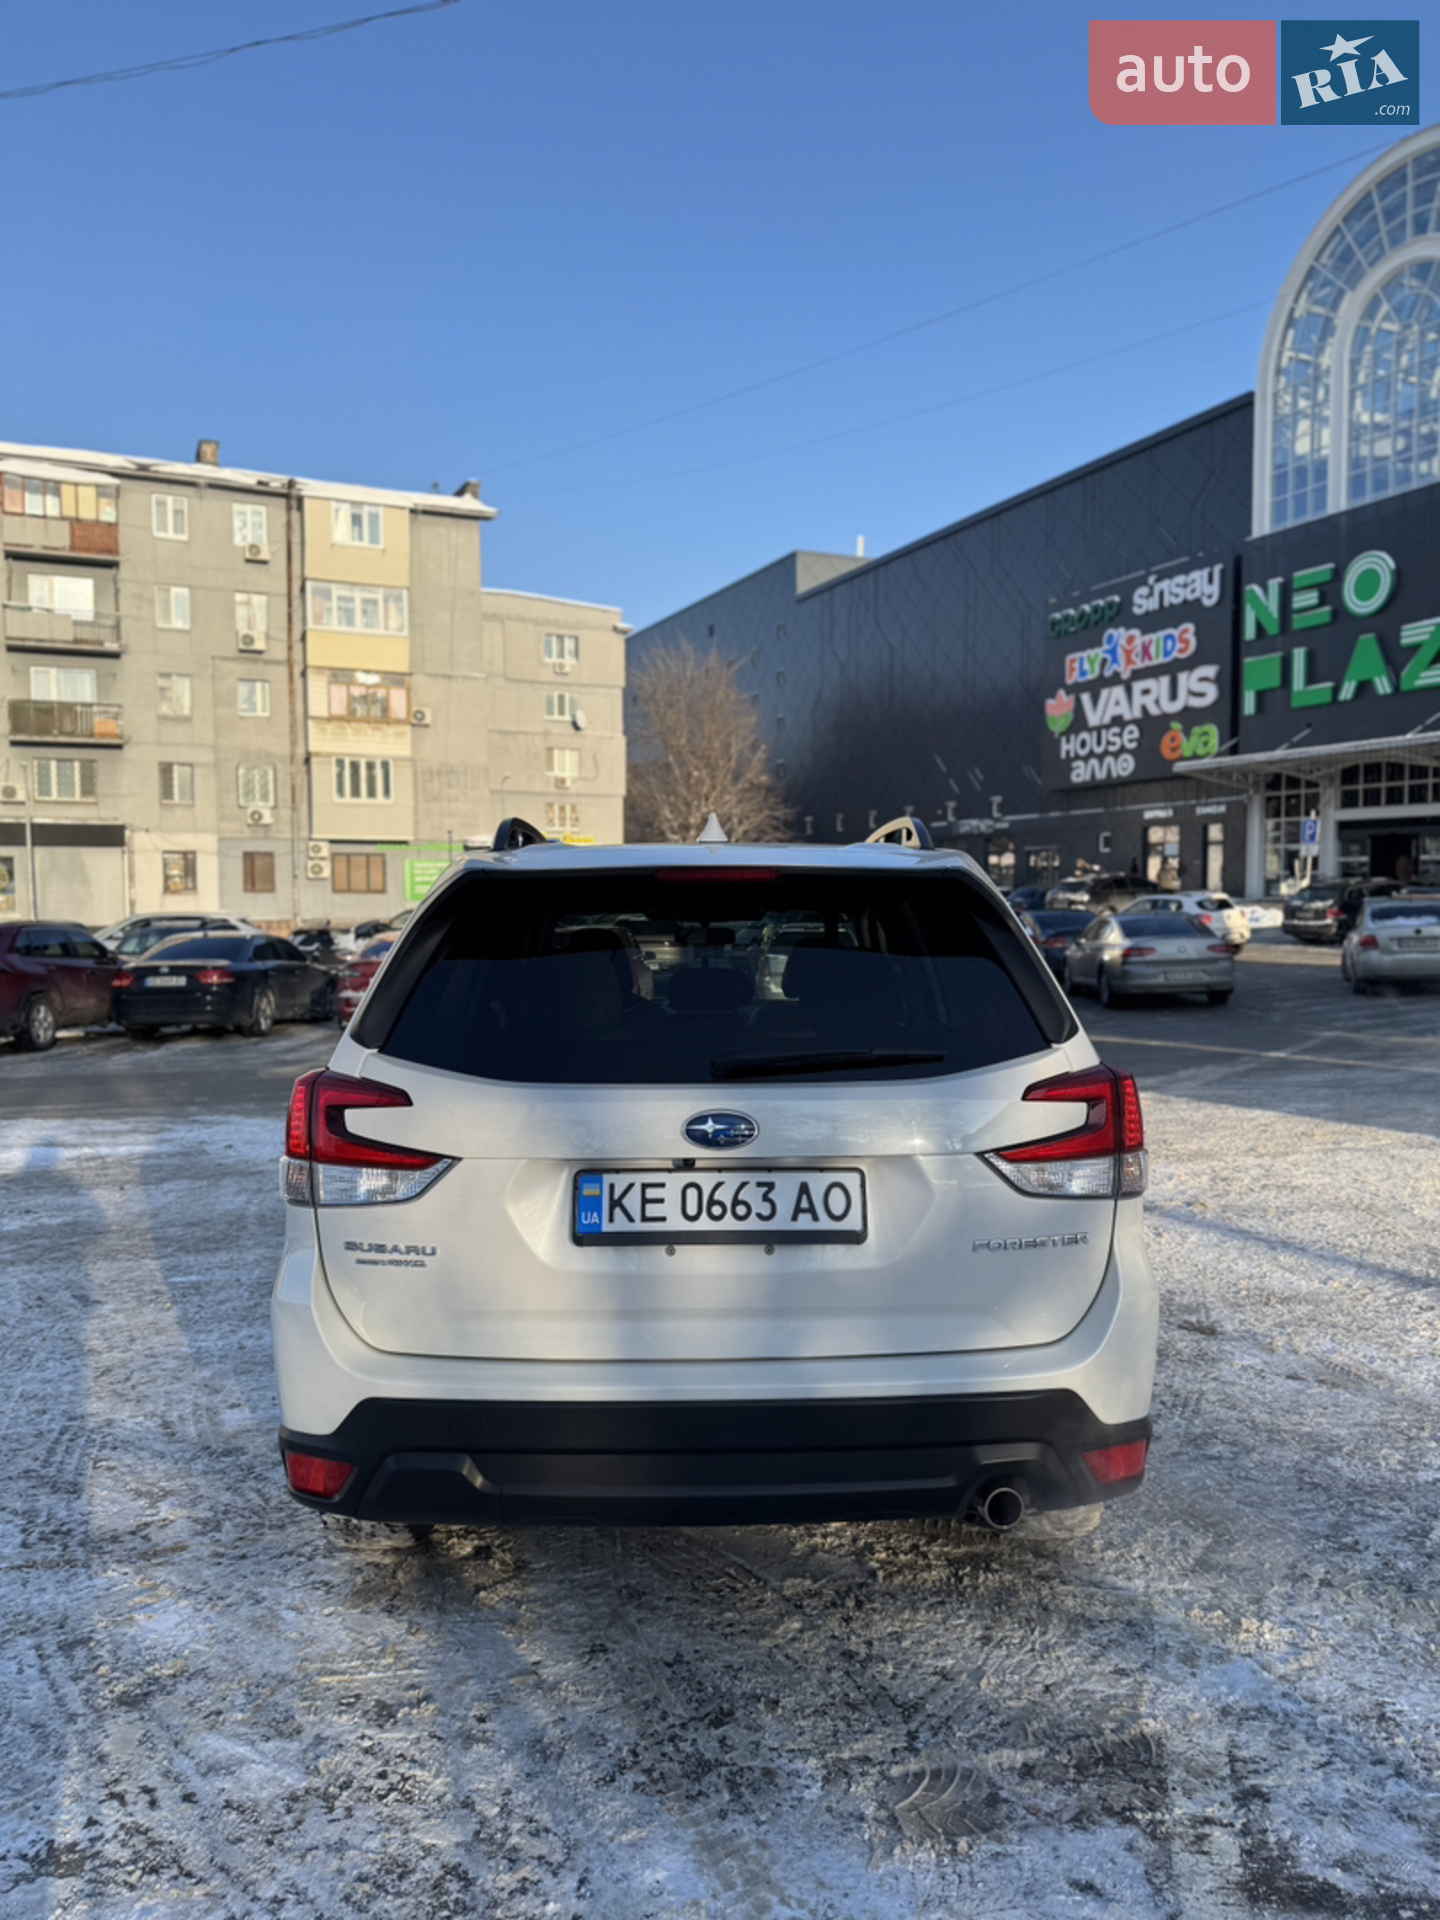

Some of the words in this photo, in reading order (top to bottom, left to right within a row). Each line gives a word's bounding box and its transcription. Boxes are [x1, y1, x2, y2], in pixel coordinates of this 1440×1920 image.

[1132, 563, 1224, 615] sinsay
[1244, 549, 1396, 641] NEO
[1065, 651, 1101, 685] FLY
[1140, 622, 1197, 667] KIDS
[1080, 665, 1220, 728] VARUS
[581, 1211, 600, 1224] UA
[608, 1182, 667, 1223] KE
[680, 1181, 777, 1222] 0663
[790, 1181, 852, 1222] AO
[343, 1241, 438, 1256] SUBARU
[972, 1231, 1090, 1253] FORESTER
